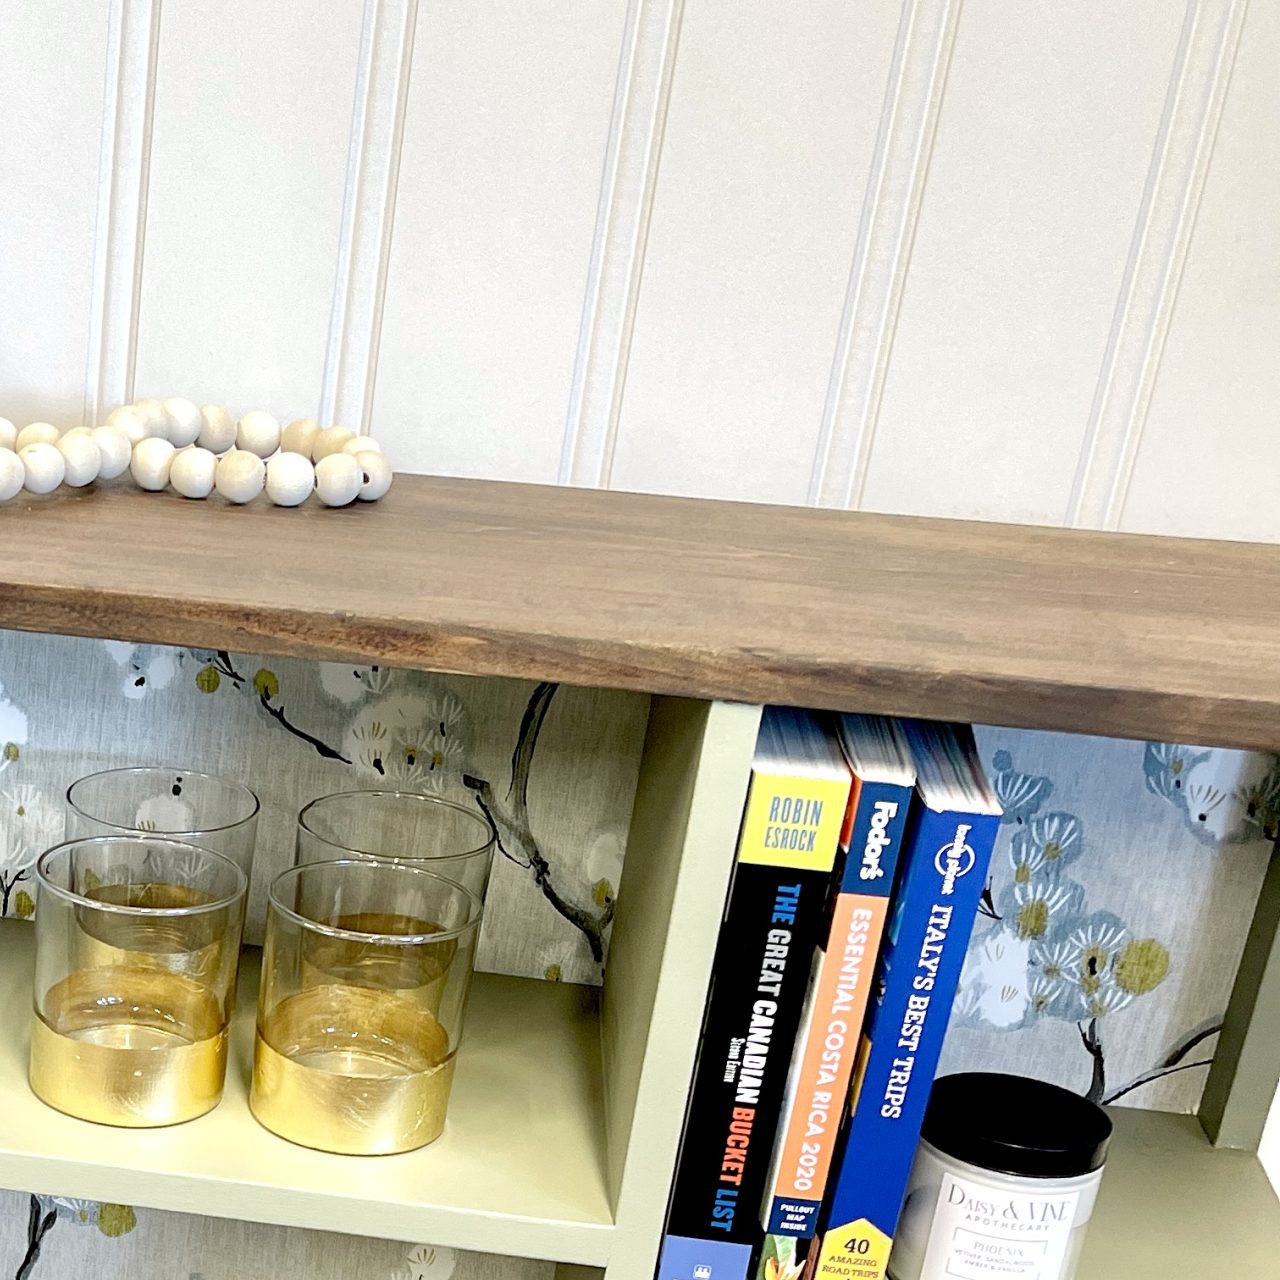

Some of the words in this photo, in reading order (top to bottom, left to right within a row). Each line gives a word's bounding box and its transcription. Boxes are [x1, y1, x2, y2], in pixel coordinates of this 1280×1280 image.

[768, 796, 823, 827] ROBIN
[764, 826, 817, 852] ESROCK
[859, 801, 898, 880] Fodor's
[771, 884, 802, 925] THE
[757, 928, 792, 997] GREAT
[831, 908, 873, 1015] ESSENTIAL
[912, 904, 954, 991] ITALY'S
[898, 994, 930, 1052] BEST
[735, 1000, 778, 1104] CANADIAN
[815, 1020, 848, 1086] COSTA
[881, 1056, 915, 1119] TRIPS
[805, 1090, 833, 1137] RICA
[720, 1107, 755, 1186] BUCKET
[793, 1142, 821, 1191] 2020
[711, 1189, 738, 1232] LIST
[786, 1213, 806, 1222] MAP
[965, 1214, 1049, 1231] APOTHECARY
[1003, 1201, 1019, 1220] &
[829, 1255, 877, 1267] AMAZING
[844, 1238, 870, 1254] 40
[974, 1241, 1024, 1257] PHOENIX
[822, 1265, 850, 1276] ROAD
[852, 1269, 879, 1278] TRIPS
